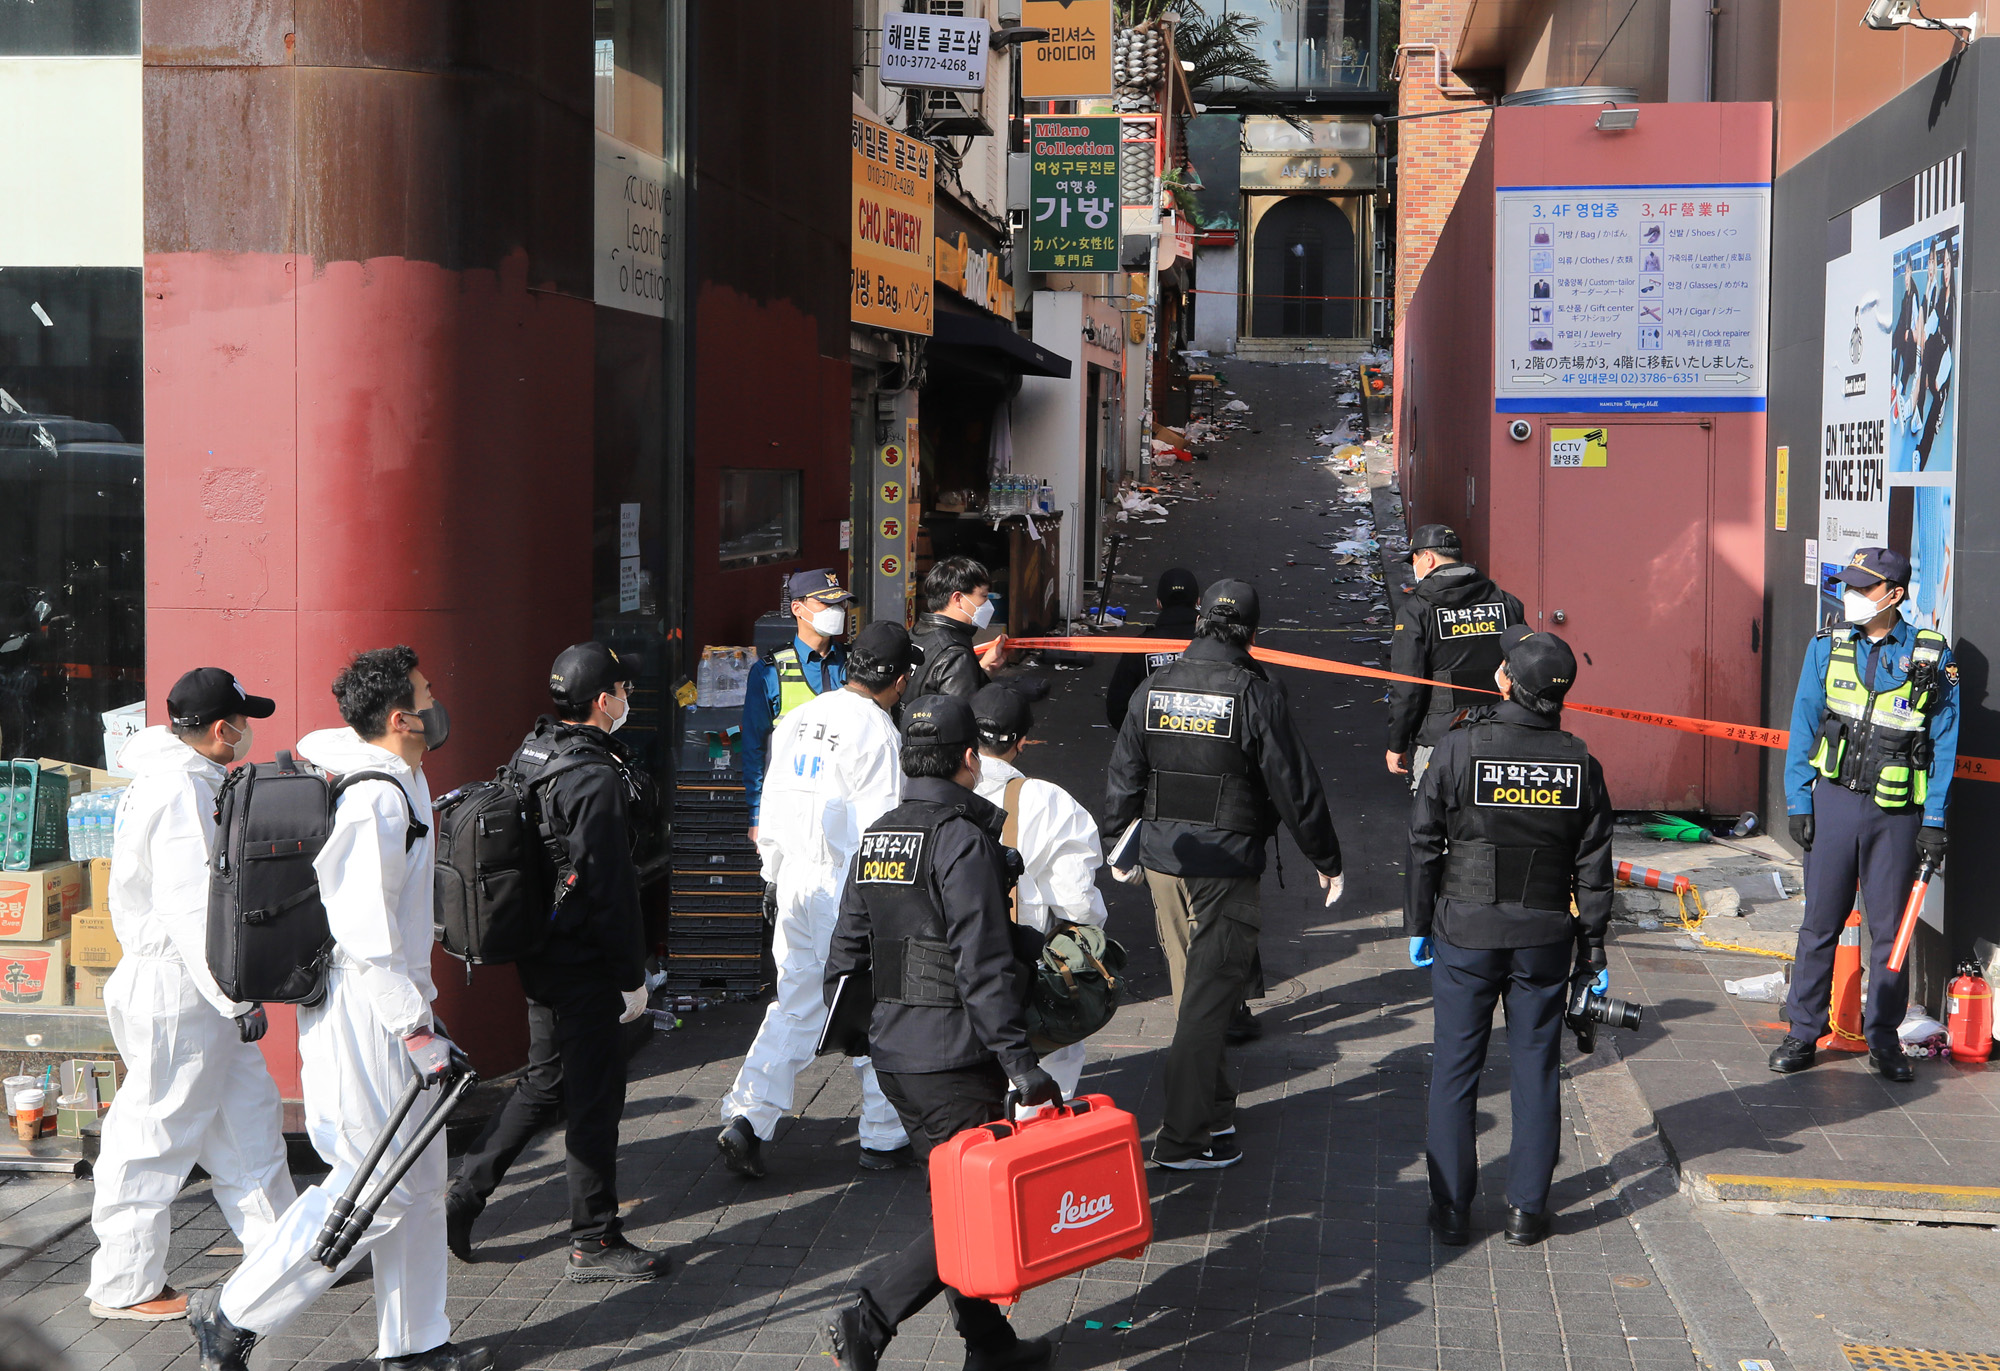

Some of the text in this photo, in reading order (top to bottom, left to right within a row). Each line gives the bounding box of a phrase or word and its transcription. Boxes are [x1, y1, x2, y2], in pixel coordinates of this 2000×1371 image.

[889, 24, 981, 56] 해밀톤 골프샵
[1037, 45, 1095, 62] 아이디어
[887, 54, 967, 71] 010-3772-4268
[968, 71, 980, 81] B1
[1035, 123, 1090, 137] Milano
[852, 118, 928, 181] 해밀톤 골프샵
[1035, 141, 1115, 155] Collection
[1034, 161, 1115, 175] 여성구두전문
[1280, 165, 1335, 178] Atelier
[1056, 180, 1097, 194] 여행용
[1036, 198, 1114, 229] 가방
[1576, 203, 1619, 218] 영업중
[859, 198, 922, 255] CHO JEWERY
[1669, 229, 1684, 238] 신발
[1691, 229, 1715, 237] Shoes
[1723, 228, 1737, 236] くつ
[1558, 231, 1573, 239] 가방
[1580, 231, 1596, 240] Bag
[1558, 256, 1572, 265] 의류
[1580, 256, 1609, 265] Clothes
[1700, 254, 1724, 262] Leather
[1589, 278, 1635, 286] Custom-tailor
[1668, 281, 1682, 290] 안경
[1689, 281, 1718, 289] Glasses
[1590, 304, 1605, 312] Gift
[1667, 307, 1683, 316] 시가
[1690, 307, 1710, 317] Cigar
[1590, 330, 1622, 339] Jewelry
[1702, 329, 1720, 337] Clock
[1722, 329, 1750, 338] repairer
[1562, 373, 1576, 384] 4F
[1578, 373, 1618, 385] 임대문의
[1826, 419, 1885, 456] ON THE SCENE
[1553, 443, 1581, 452] CCTV
[1553, 455, 1580, 465] 촬영중
[1825, 458, 1884, 502] SINCE 1974
[1442, 606, 1501, 624] 과학수사
[1452, 621, 1496, 636] POLICE
[1152, 695, 1232, 718] 과학수사
[1160, 715, 1216, 733] POLICE
[1725, 727, 1781, 745] 경찰통제선
[1483, 764, 1573, 787] 과학수사
[1493, 788, 1562, 805] POLICE
[862, 837, 917, 859] 과학수사
[864, 861, 906, 879] POLICE
[1051, 1190, 1114, 1234] Leica
